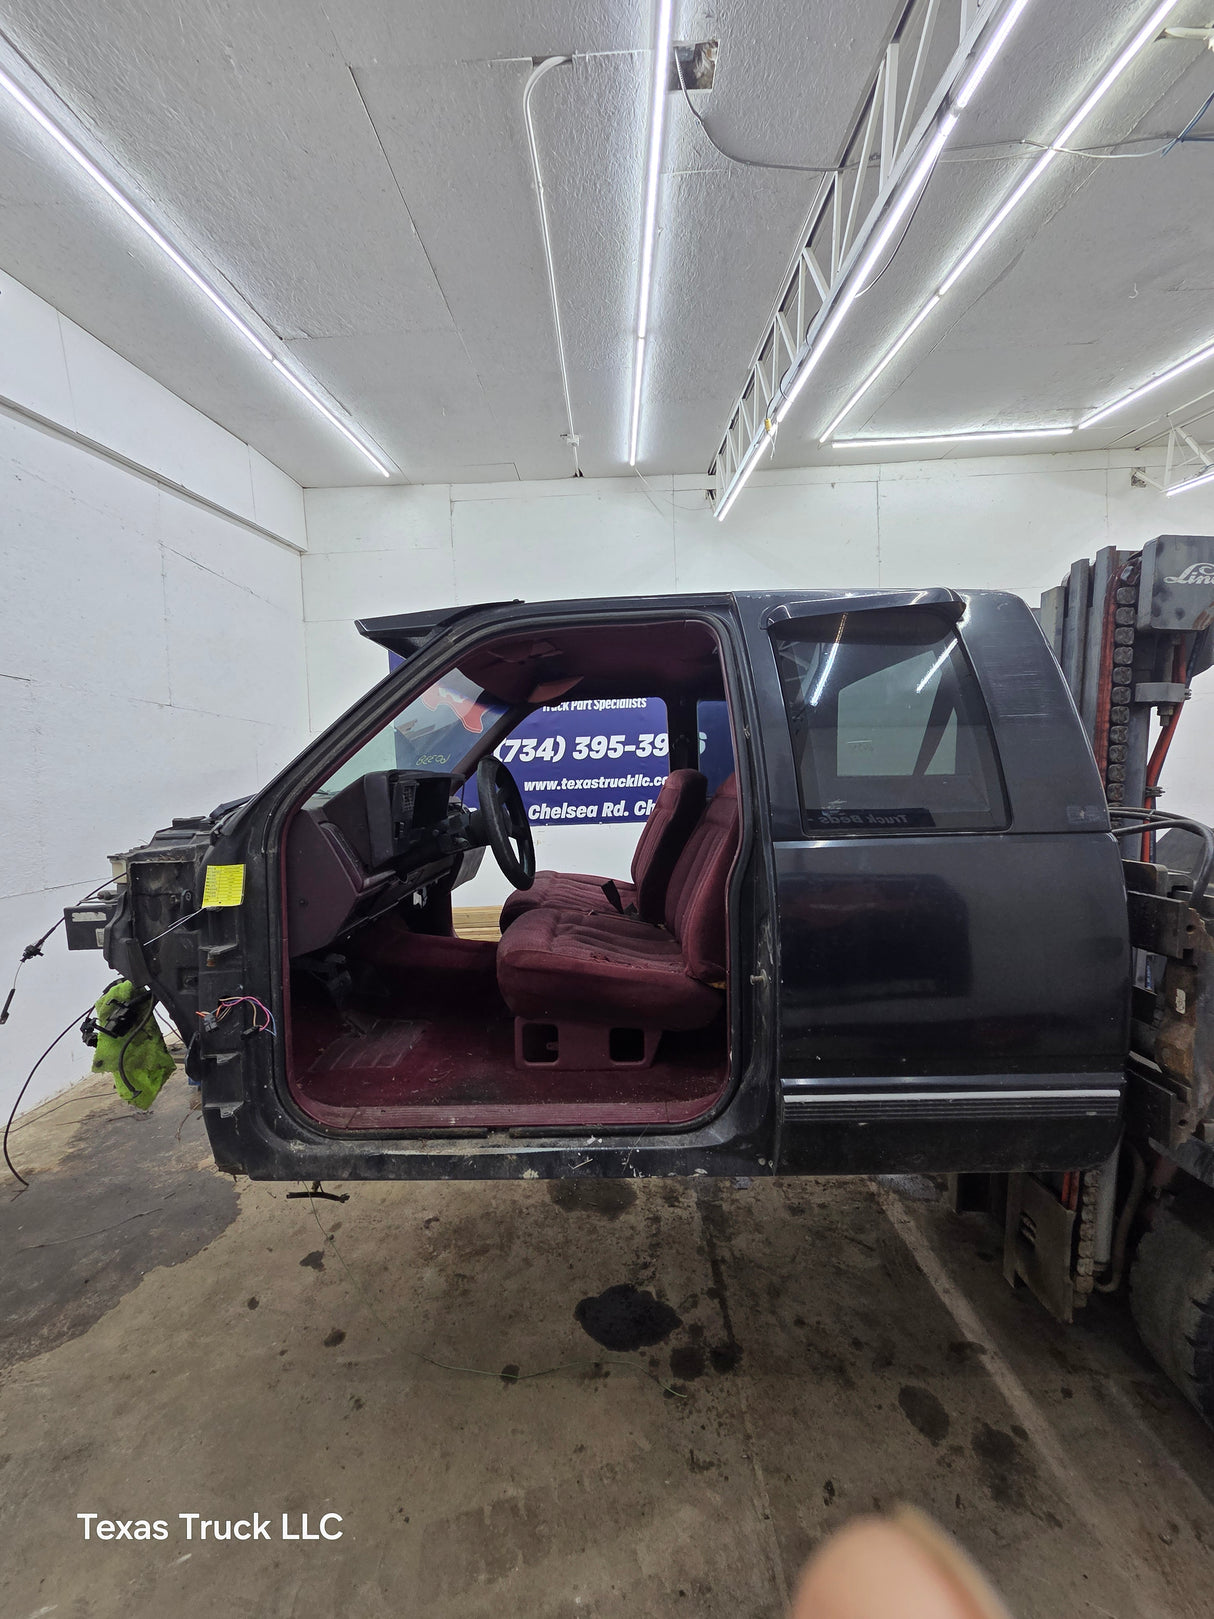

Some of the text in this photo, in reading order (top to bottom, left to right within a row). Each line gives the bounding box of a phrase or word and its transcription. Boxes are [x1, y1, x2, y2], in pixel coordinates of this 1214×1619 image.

[1163, 562, 1214, 585] Lin
[571, 700, 592, 711] Part
[594, 698, 647, 711] Specialists
[493, 732, 707, 763] (734) 395-39
[528, 803, 598, 819] Chelsea
[601, 799, 630, 817] Rd.
